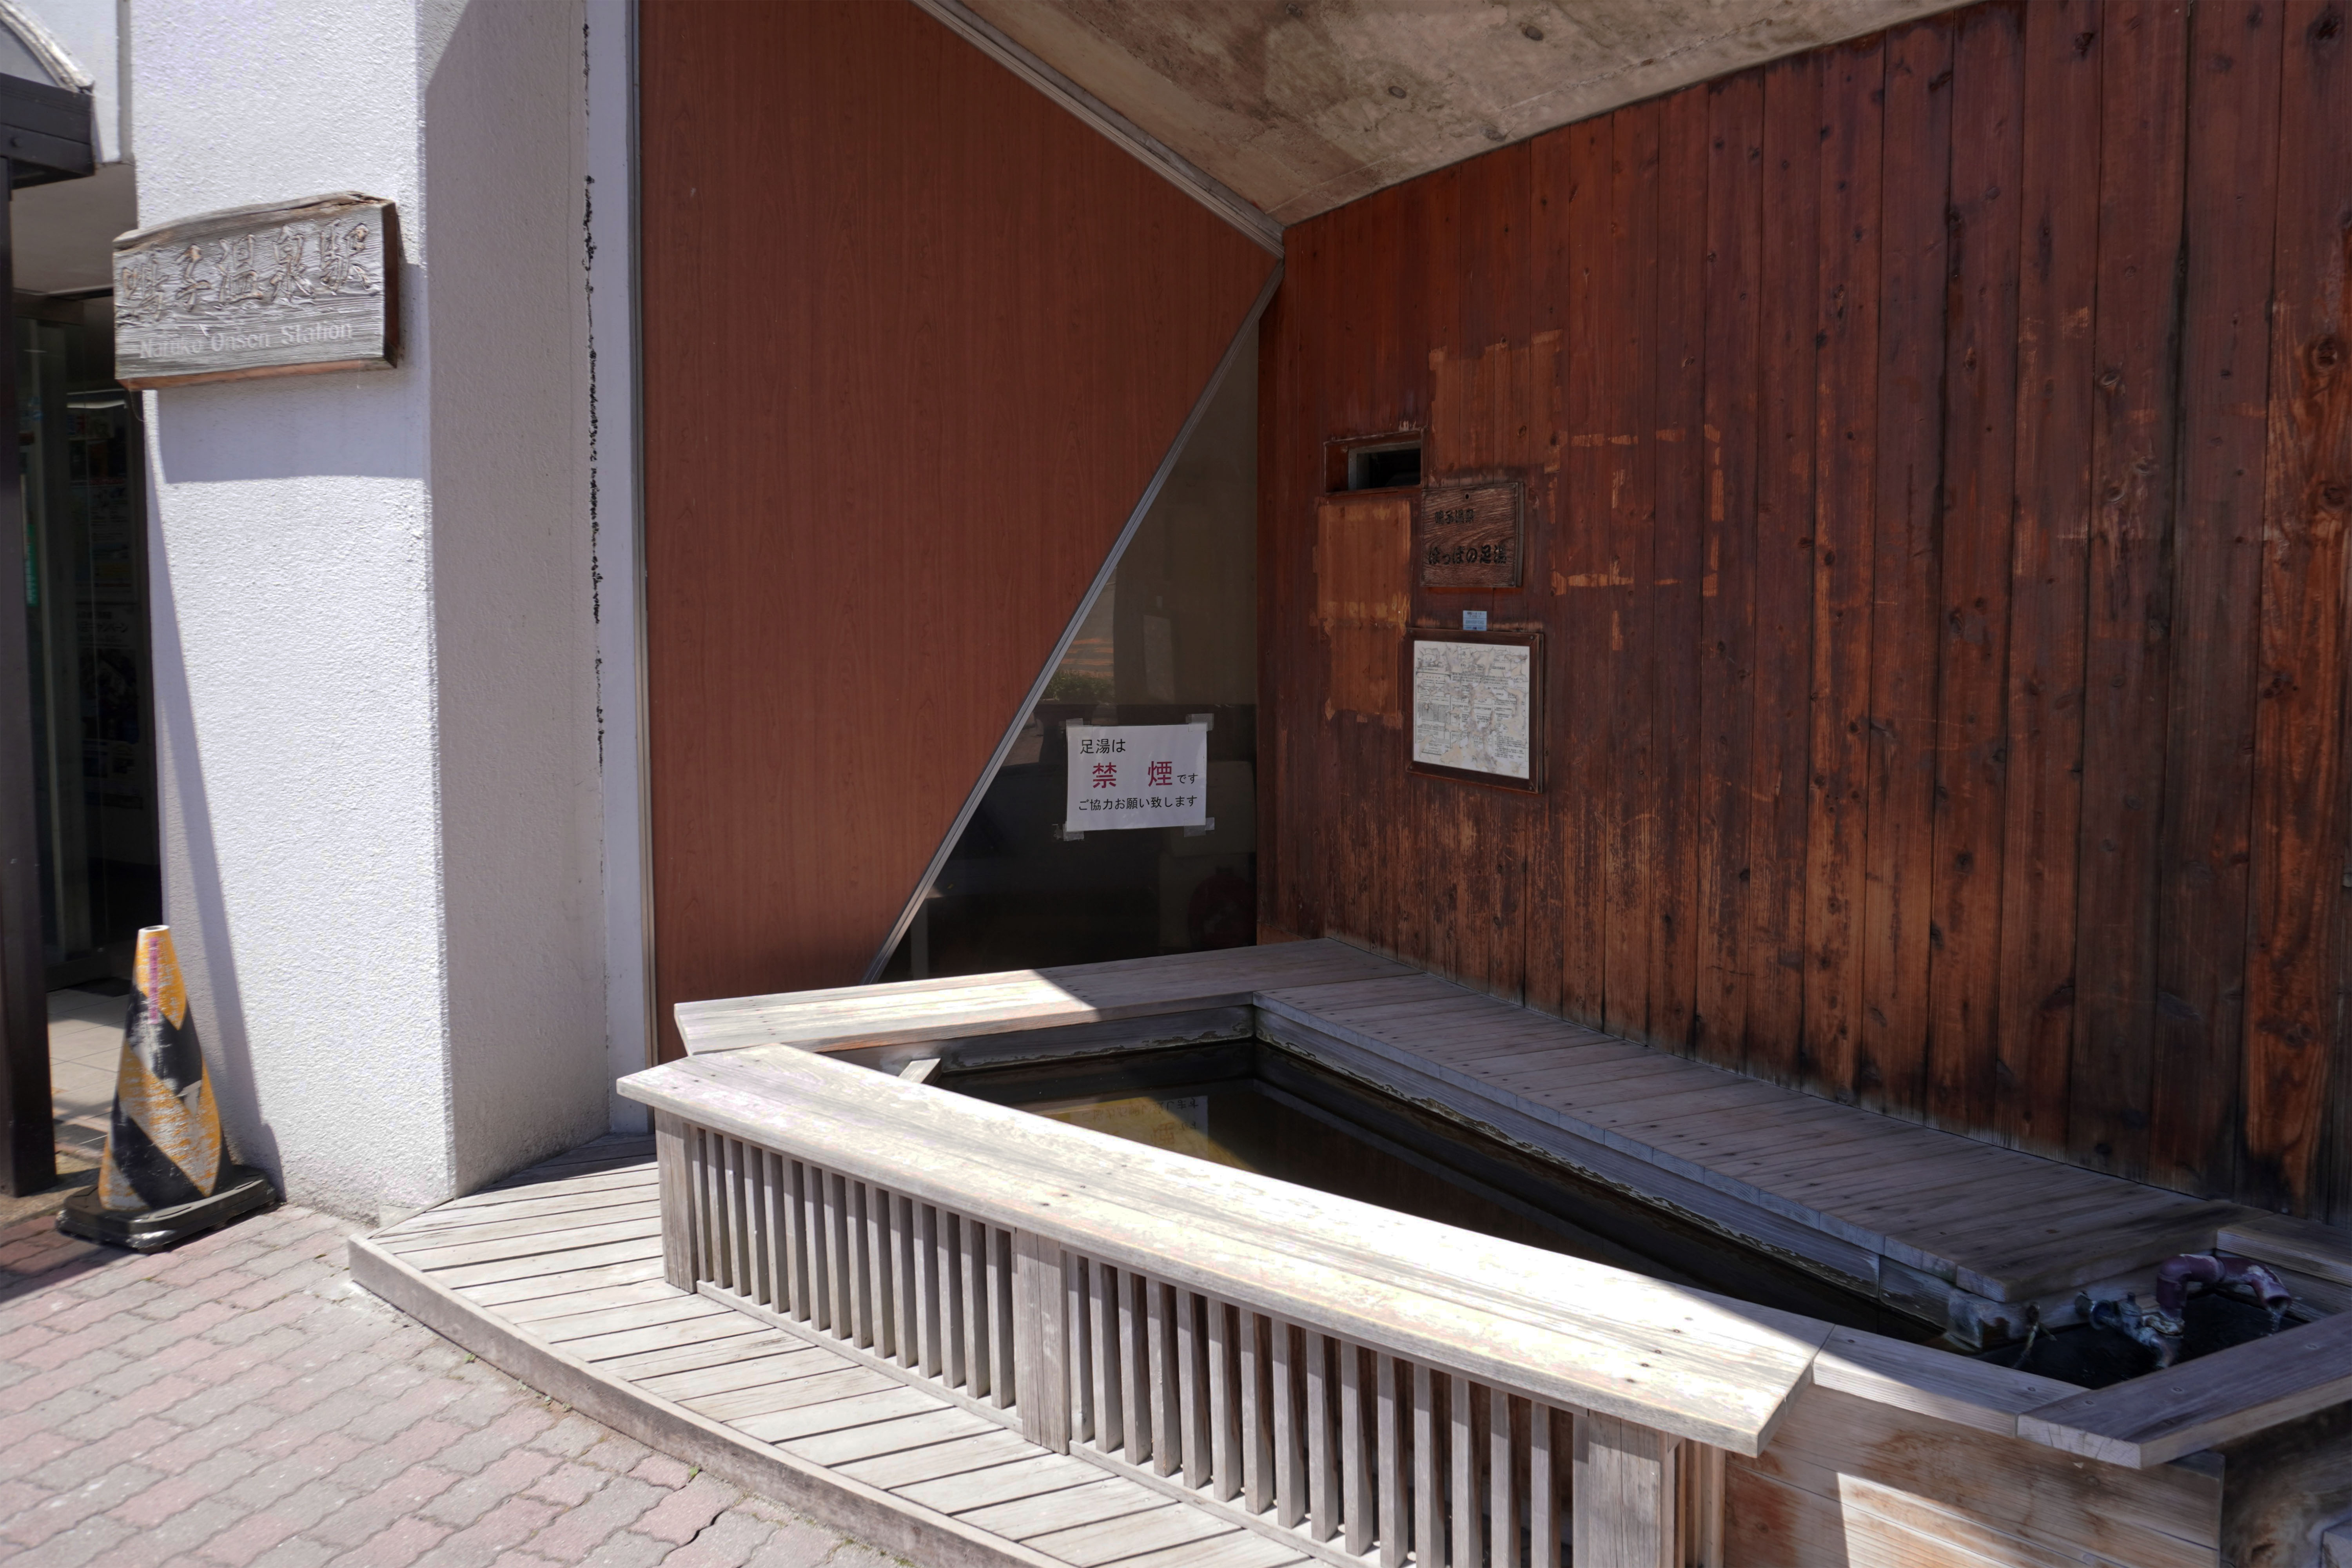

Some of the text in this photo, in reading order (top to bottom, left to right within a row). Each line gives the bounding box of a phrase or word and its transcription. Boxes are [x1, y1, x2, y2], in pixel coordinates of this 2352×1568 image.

[140, 323, 353, 358] Naruko Onsen Station
[1080, 739, 1126, 754] 足湯は
[1078, 795, 1198, 811] ご協力お願い致します
